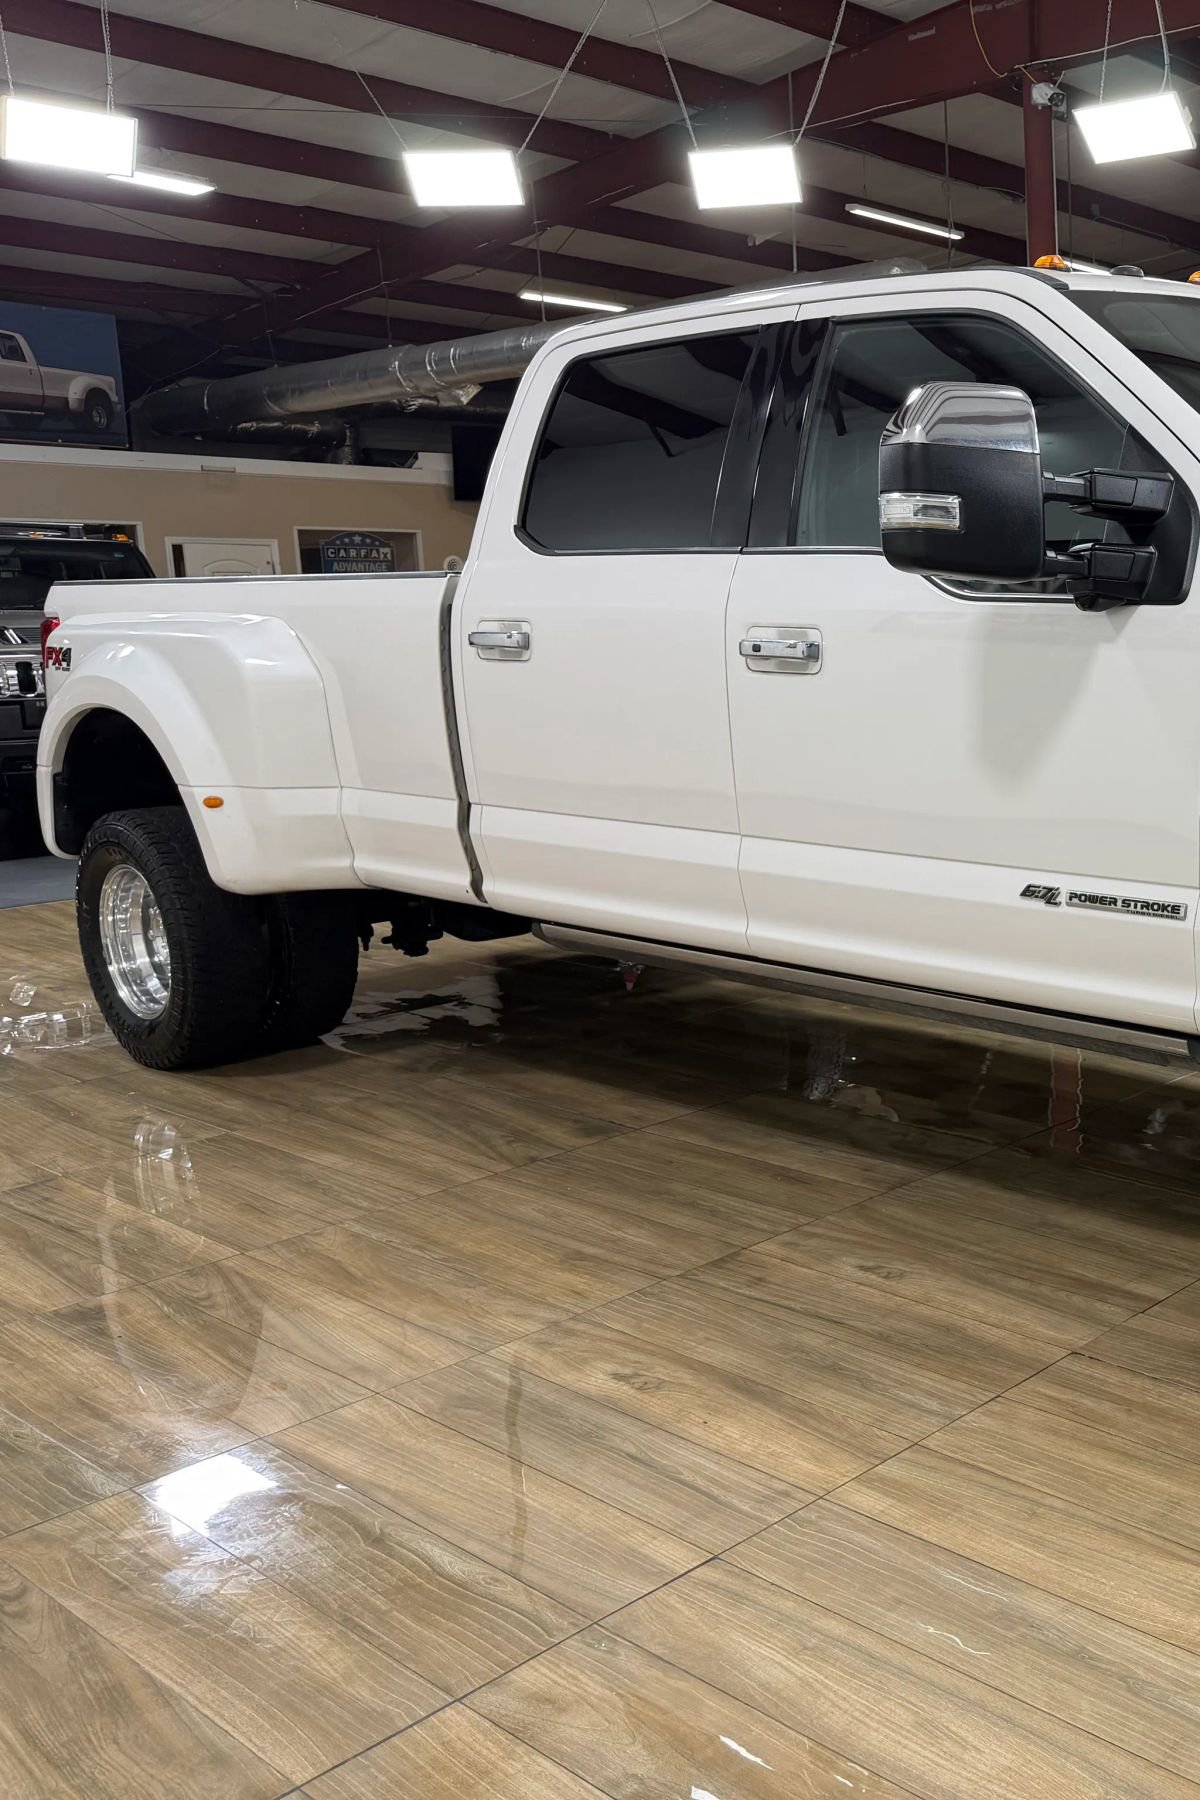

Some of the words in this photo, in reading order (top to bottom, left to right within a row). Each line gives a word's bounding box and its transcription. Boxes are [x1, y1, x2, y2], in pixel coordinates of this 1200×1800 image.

[327, 548, 390, 560] CARFAX
[332, 561, 389, 572] ADVANTAGE
[46, 646, 72, 669] FX4
[1068, 891, 1118, 908] POWER
[1121, 898, 1182, 915] STROKE
